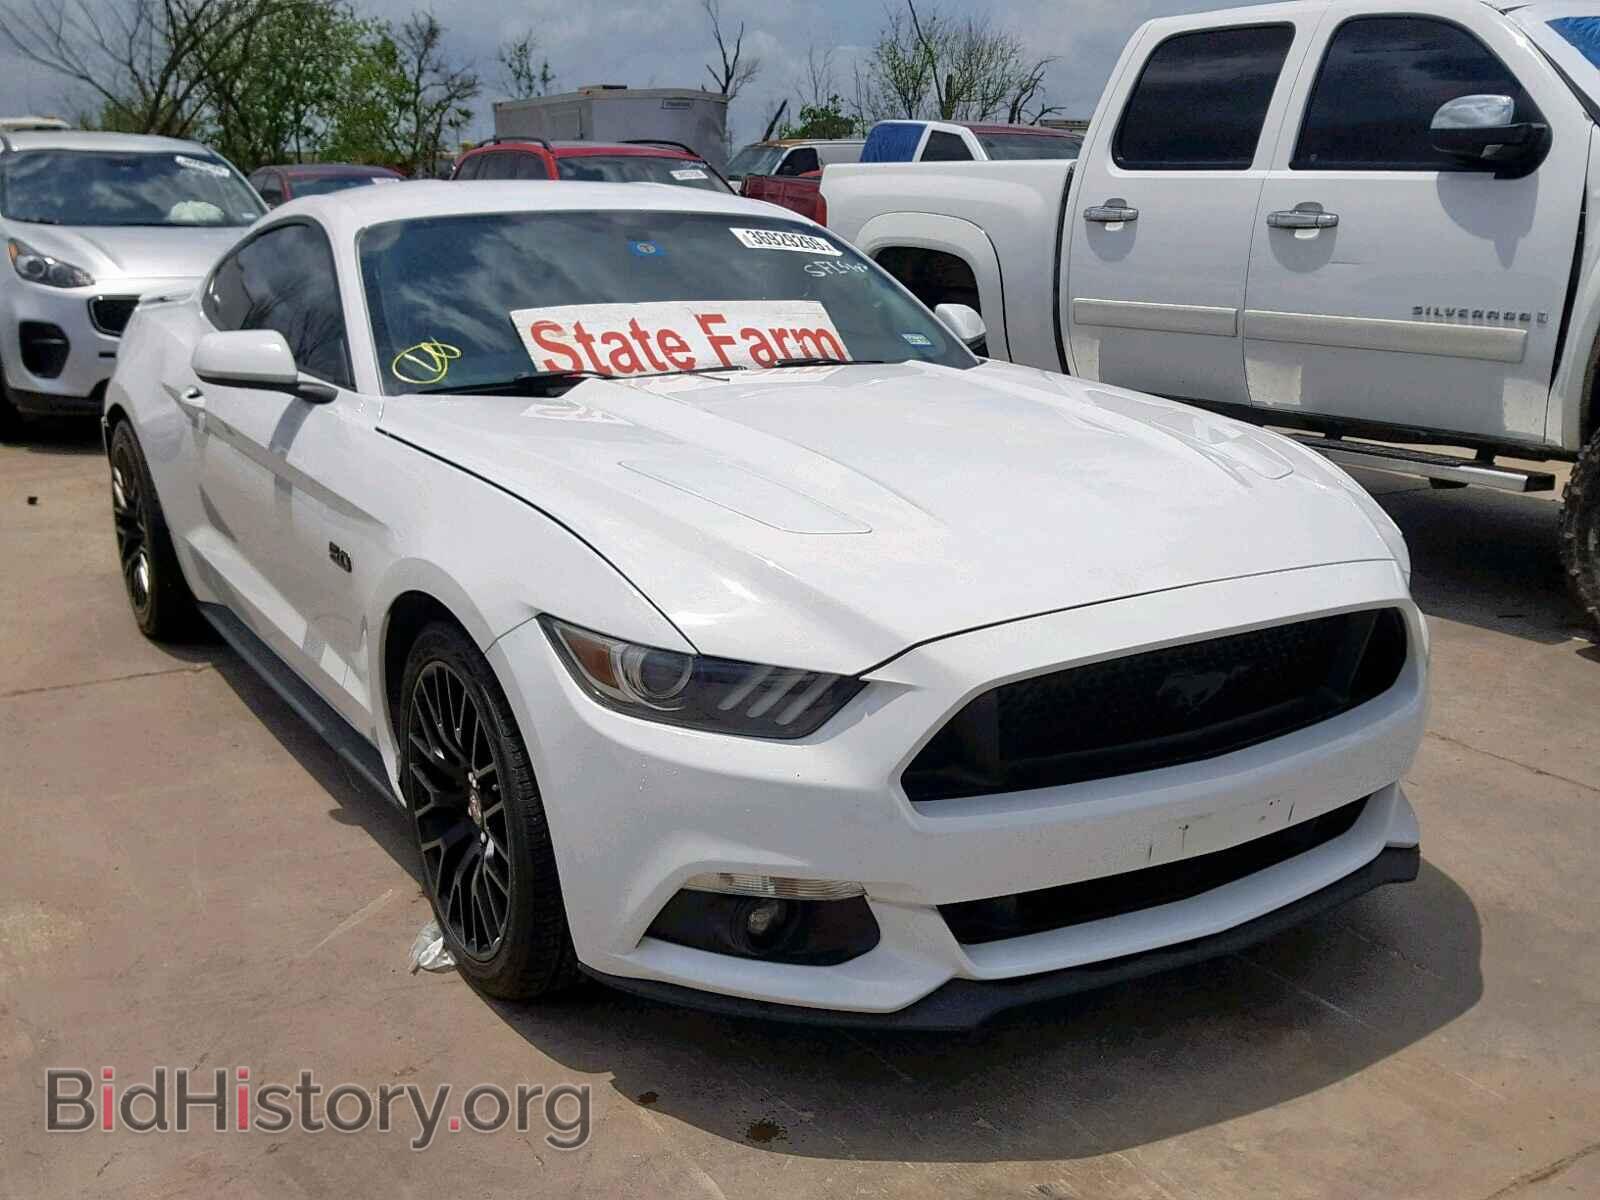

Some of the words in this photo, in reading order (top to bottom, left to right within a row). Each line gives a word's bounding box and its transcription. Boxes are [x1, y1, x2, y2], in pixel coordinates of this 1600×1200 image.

[745, 230, 825, 251] 36929269
[1412, 305, 1531, 322] SILVERADO
[530, 317, 697, 376] State
[694, 313, 847, 368] Farm
